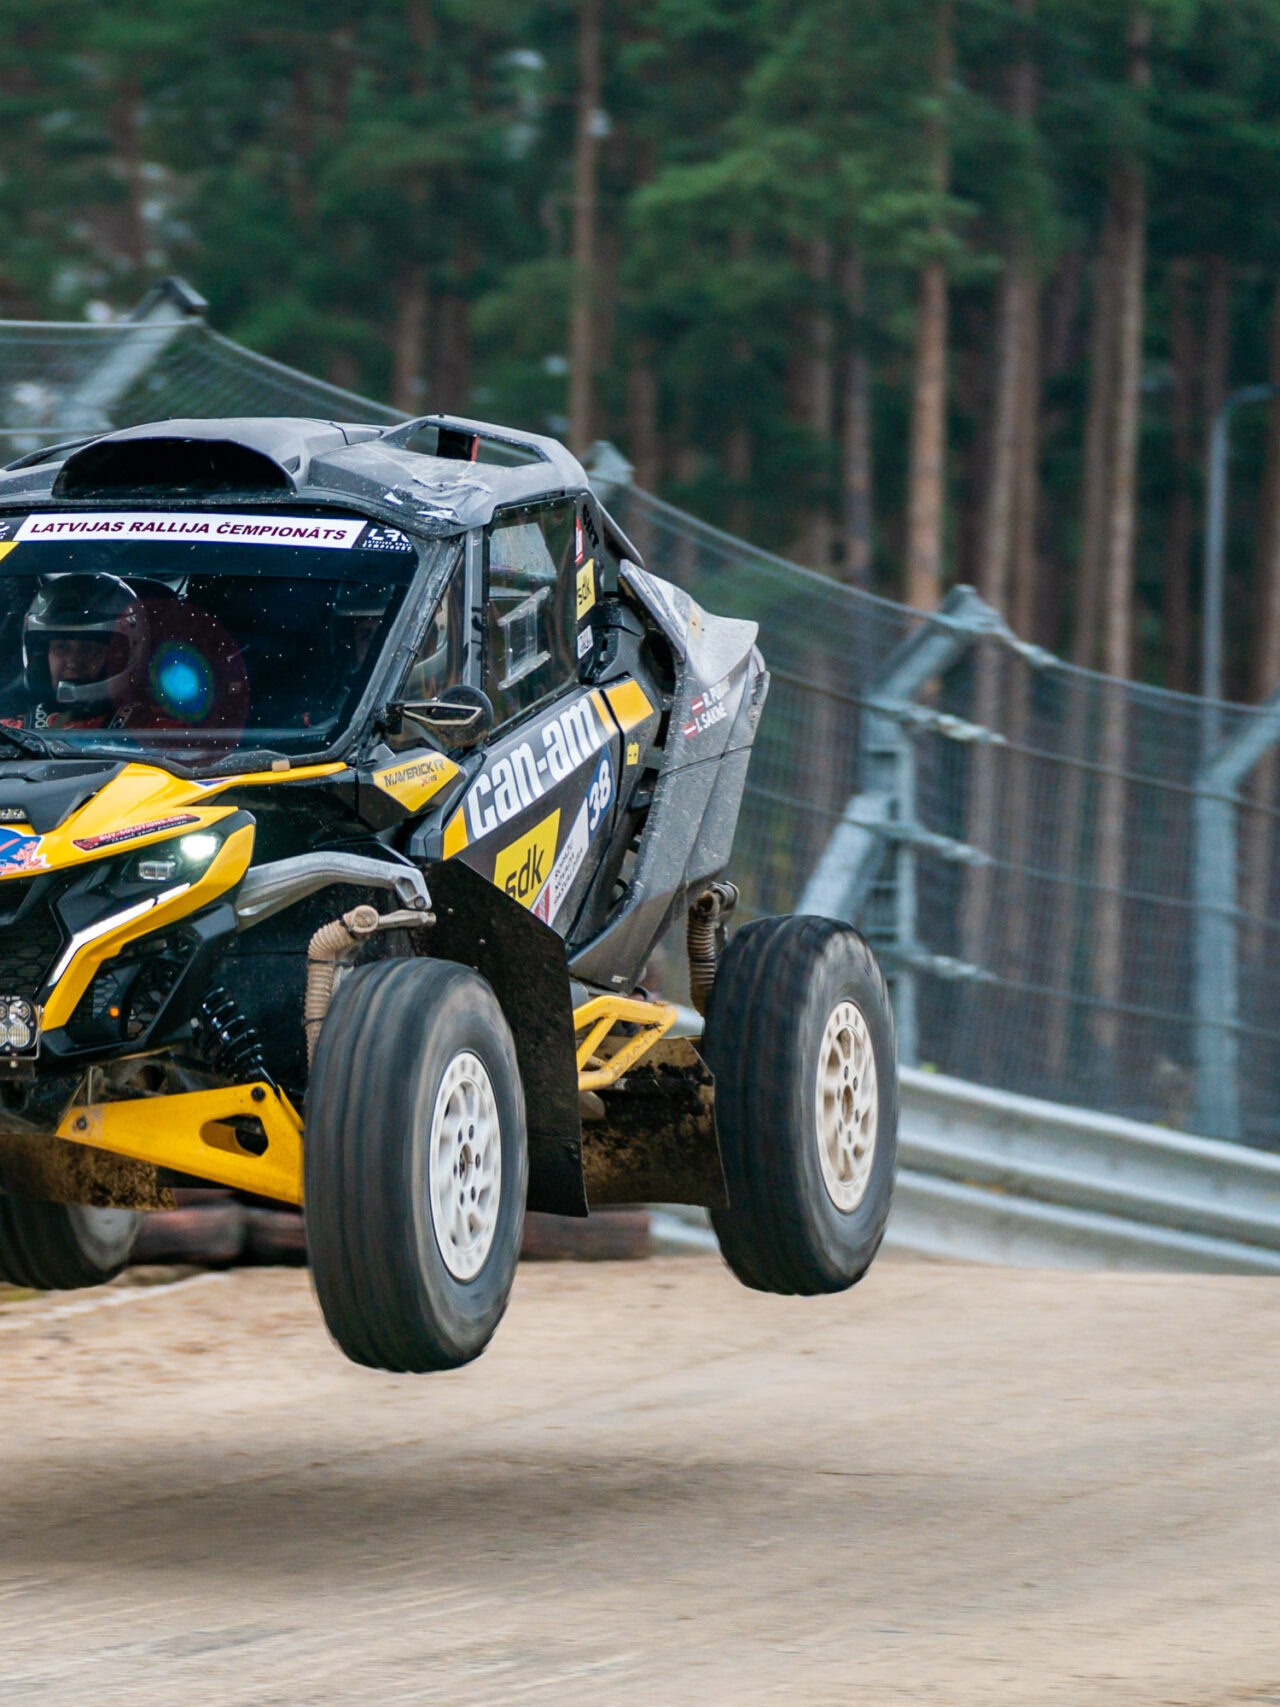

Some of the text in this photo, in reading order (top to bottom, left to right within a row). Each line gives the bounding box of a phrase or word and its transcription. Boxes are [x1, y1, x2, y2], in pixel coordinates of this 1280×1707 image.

[30, 521, 347, 540] LATVIJAS RALLIJA ČEMPIONĀTS
[384, 761, 434, 787] MAVERICK
[467, 697, 602, 840] can-am
[588, 760, 611, 832] 38
[505, 844, 544, 898] sdk
